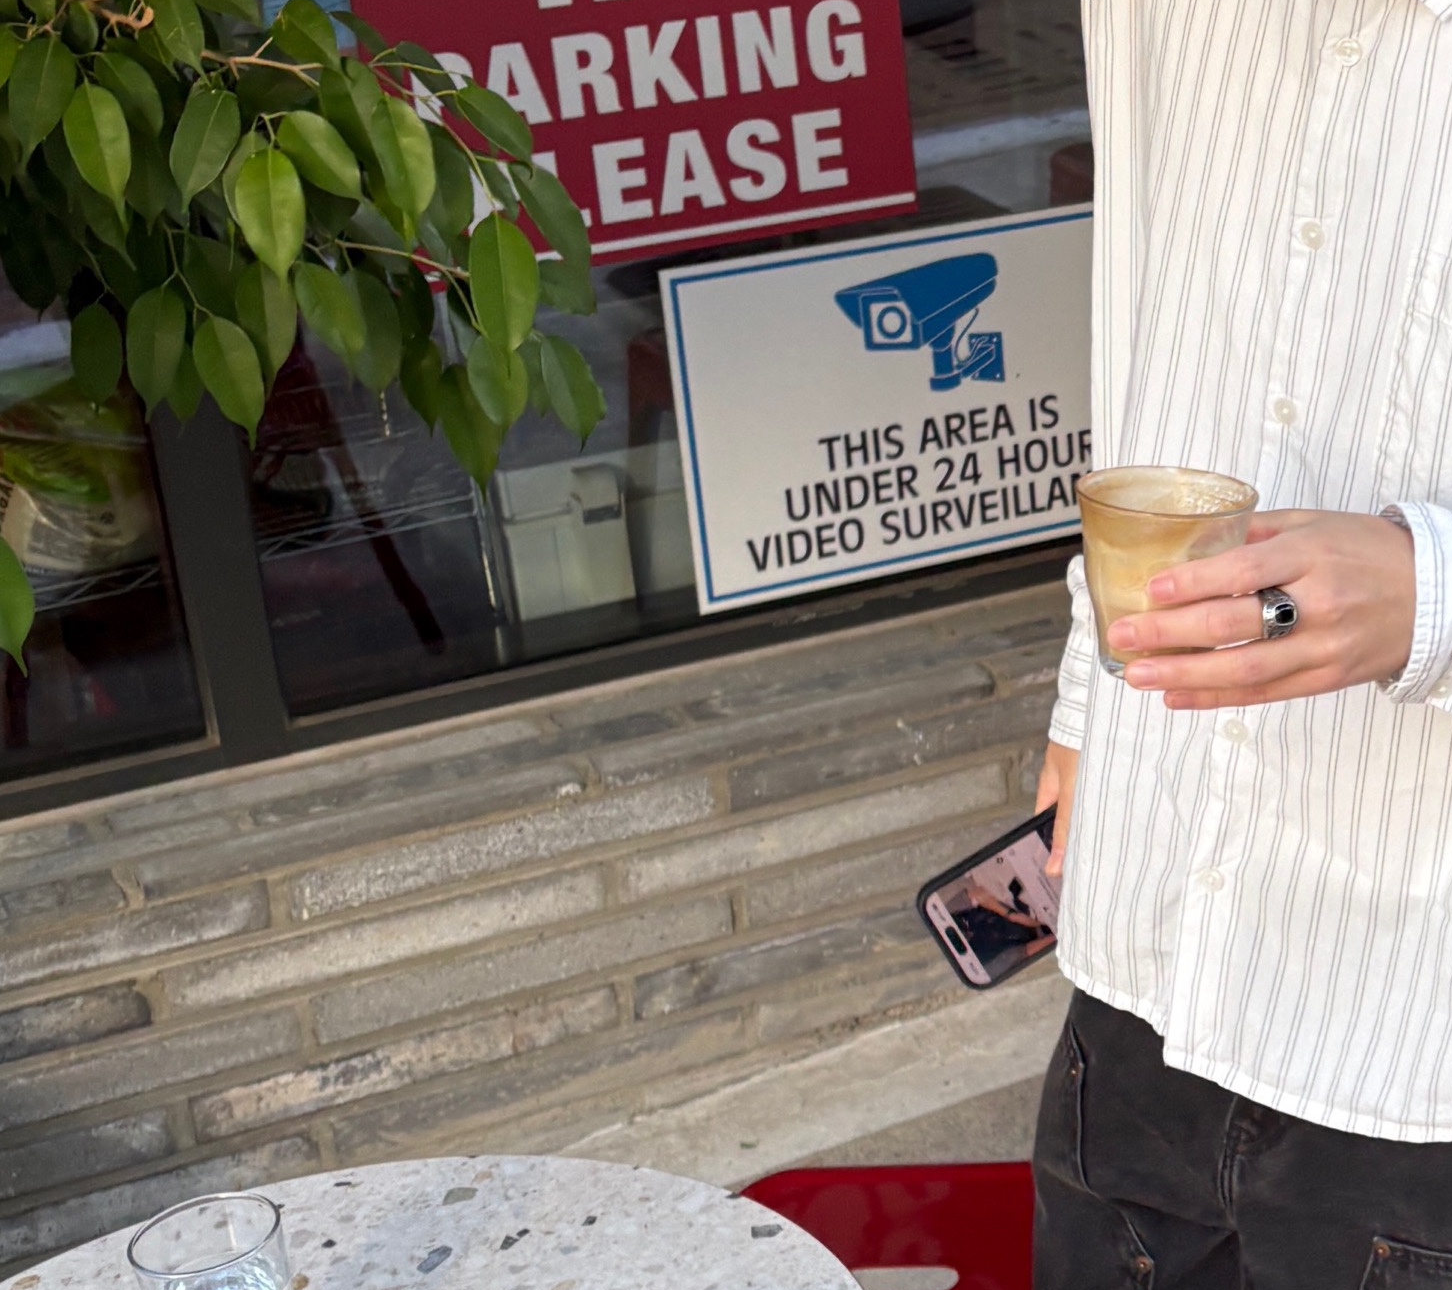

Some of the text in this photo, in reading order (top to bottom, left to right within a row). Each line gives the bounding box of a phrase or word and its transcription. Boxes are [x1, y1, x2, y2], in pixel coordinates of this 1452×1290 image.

[468, 107, 850, 237] EASE
[784, 428, 1092, 523] UNDER 24 HOUR
[818, 393, 1061, 473] THIS AREA IS
[746, 518, 865, 574] VIDEO
